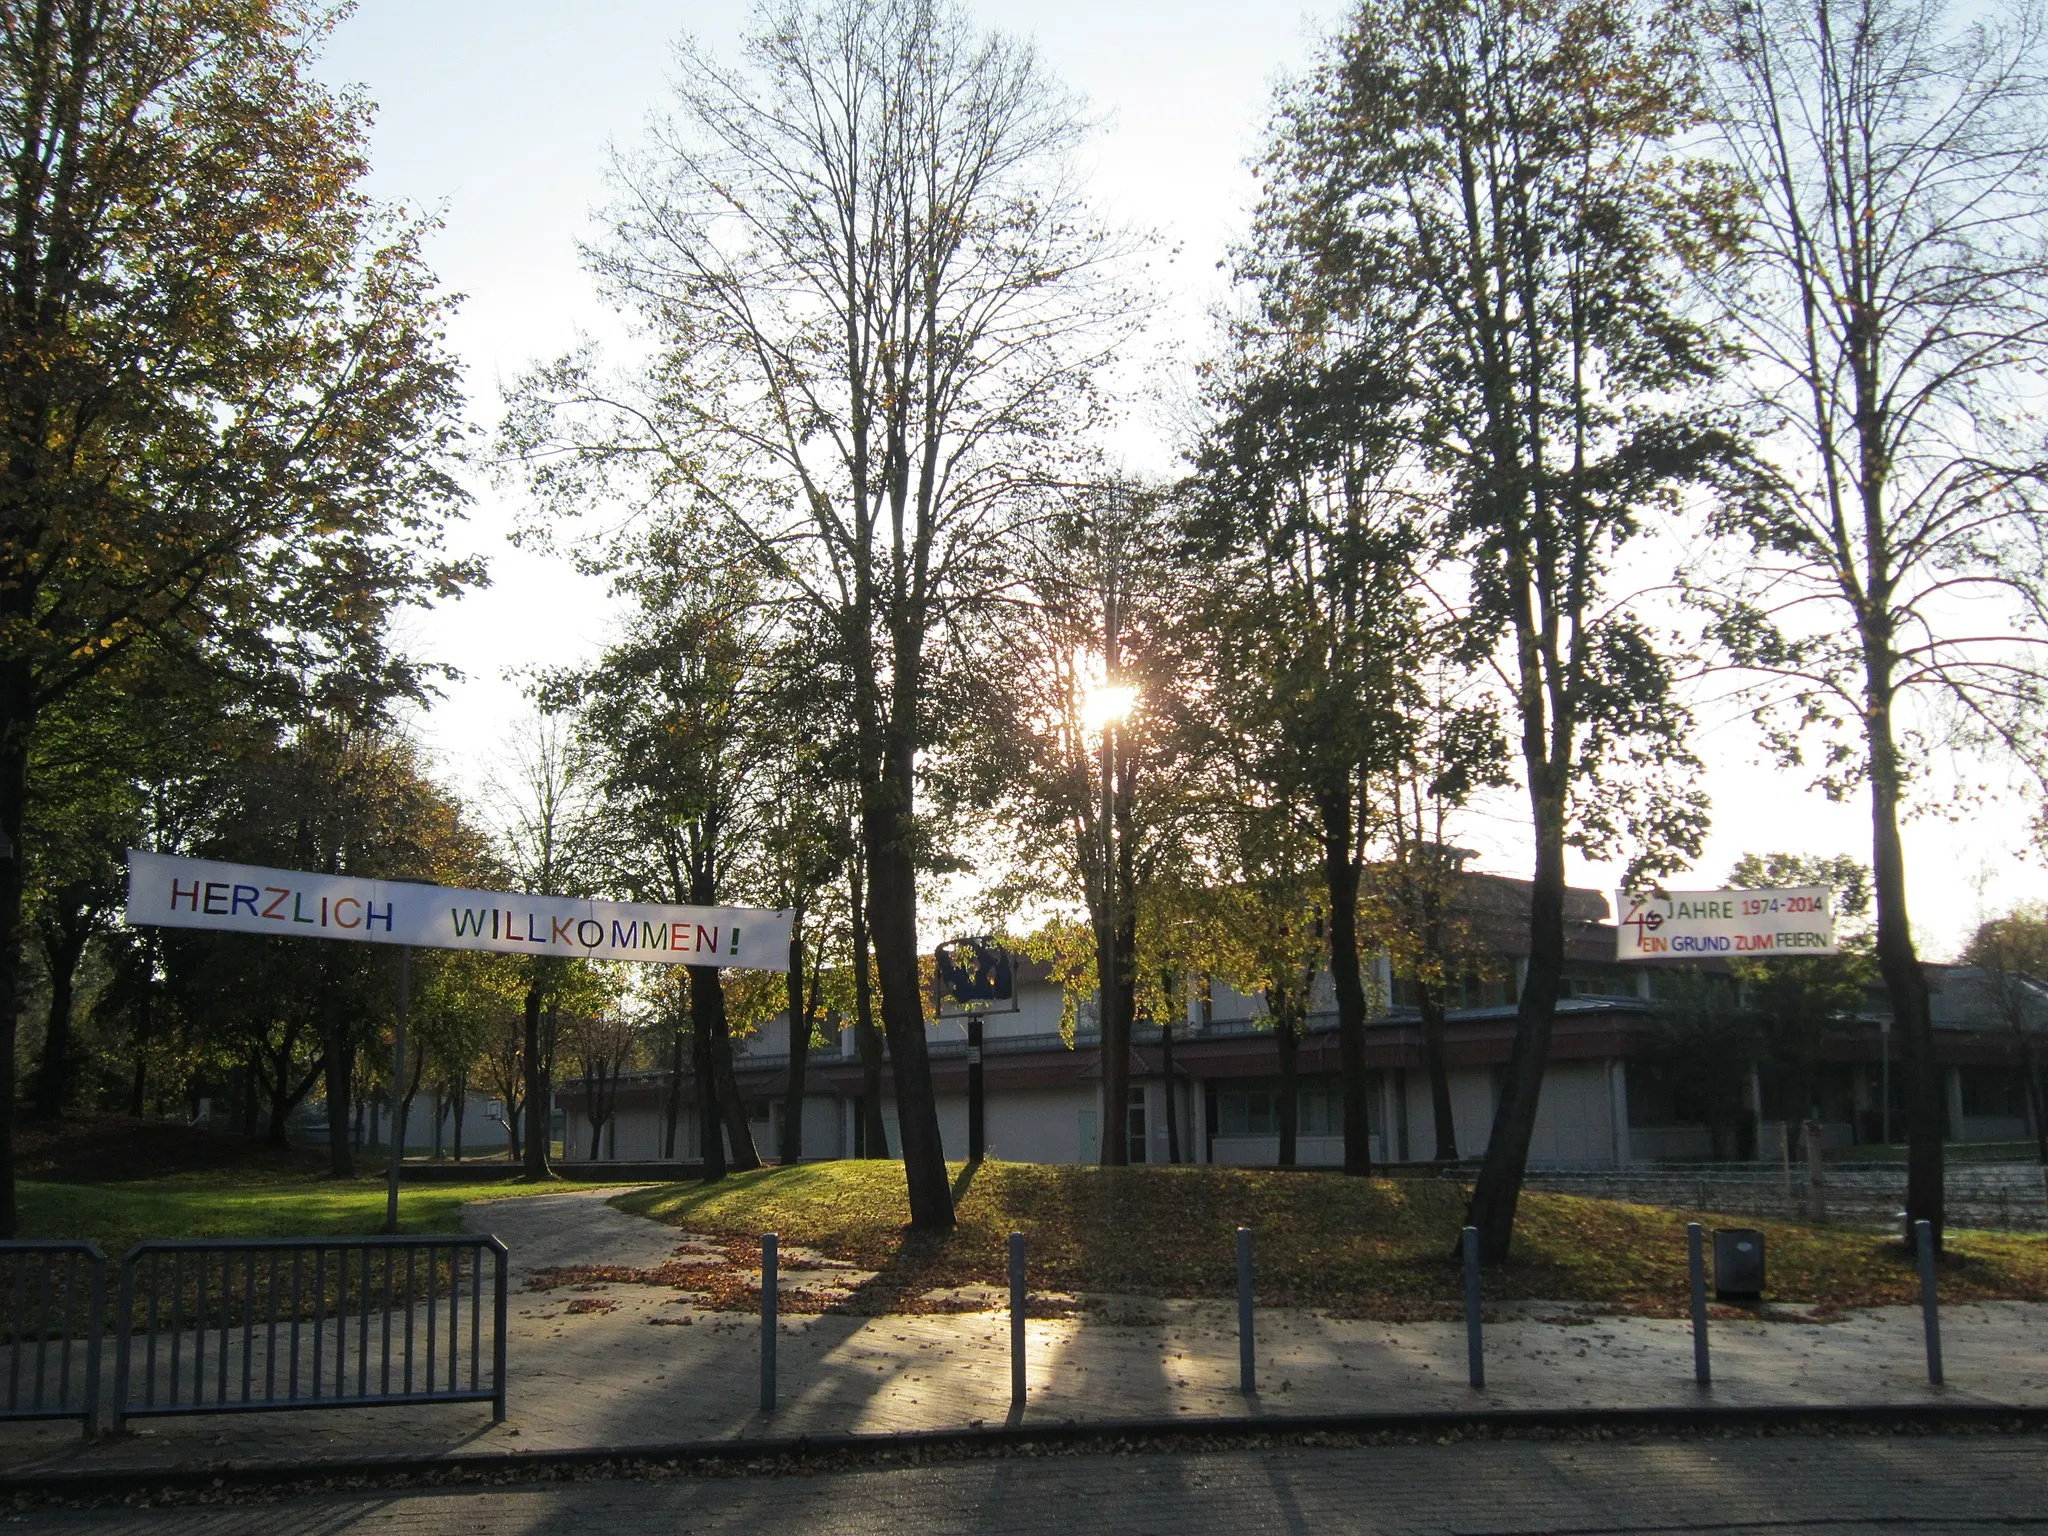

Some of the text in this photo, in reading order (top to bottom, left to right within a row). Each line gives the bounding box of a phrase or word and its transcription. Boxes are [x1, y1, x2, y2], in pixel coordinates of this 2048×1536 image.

[169, 878, 394, 932] HERZLICH
[1667, 900, 1733, 919] JAHRE
[1742, 897, 1823, 916] 1974-2014
[1642, 932, 1828, 953] EIN GRUND ZUM FEIERN
